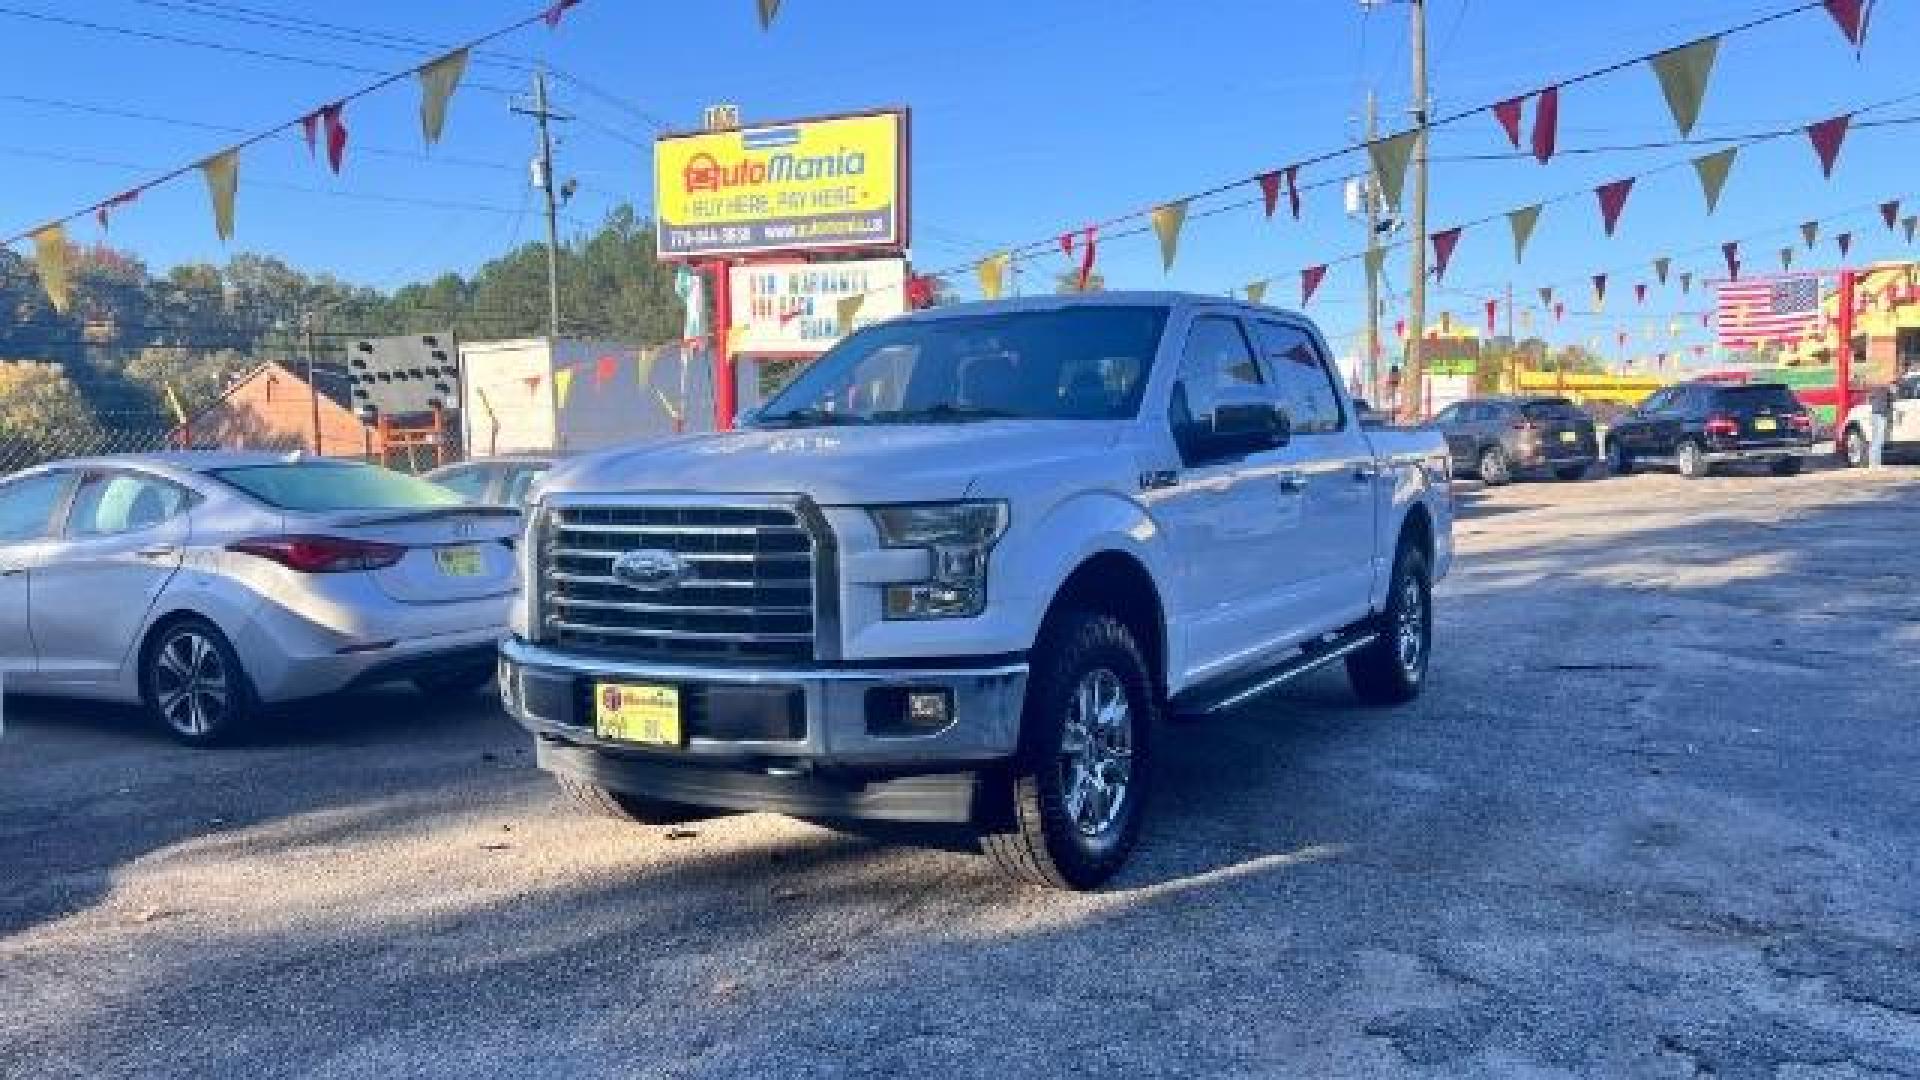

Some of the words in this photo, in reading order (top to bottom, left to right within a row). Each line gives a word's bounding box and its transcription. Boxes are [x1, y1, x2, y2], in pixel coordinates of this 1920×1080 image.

[683, 146, 866, 193] AutoMania
[692, 198, 721, 217] BUY
[777, 190, 808, 210] PAY
[812, 186, 856, 206] HERE
